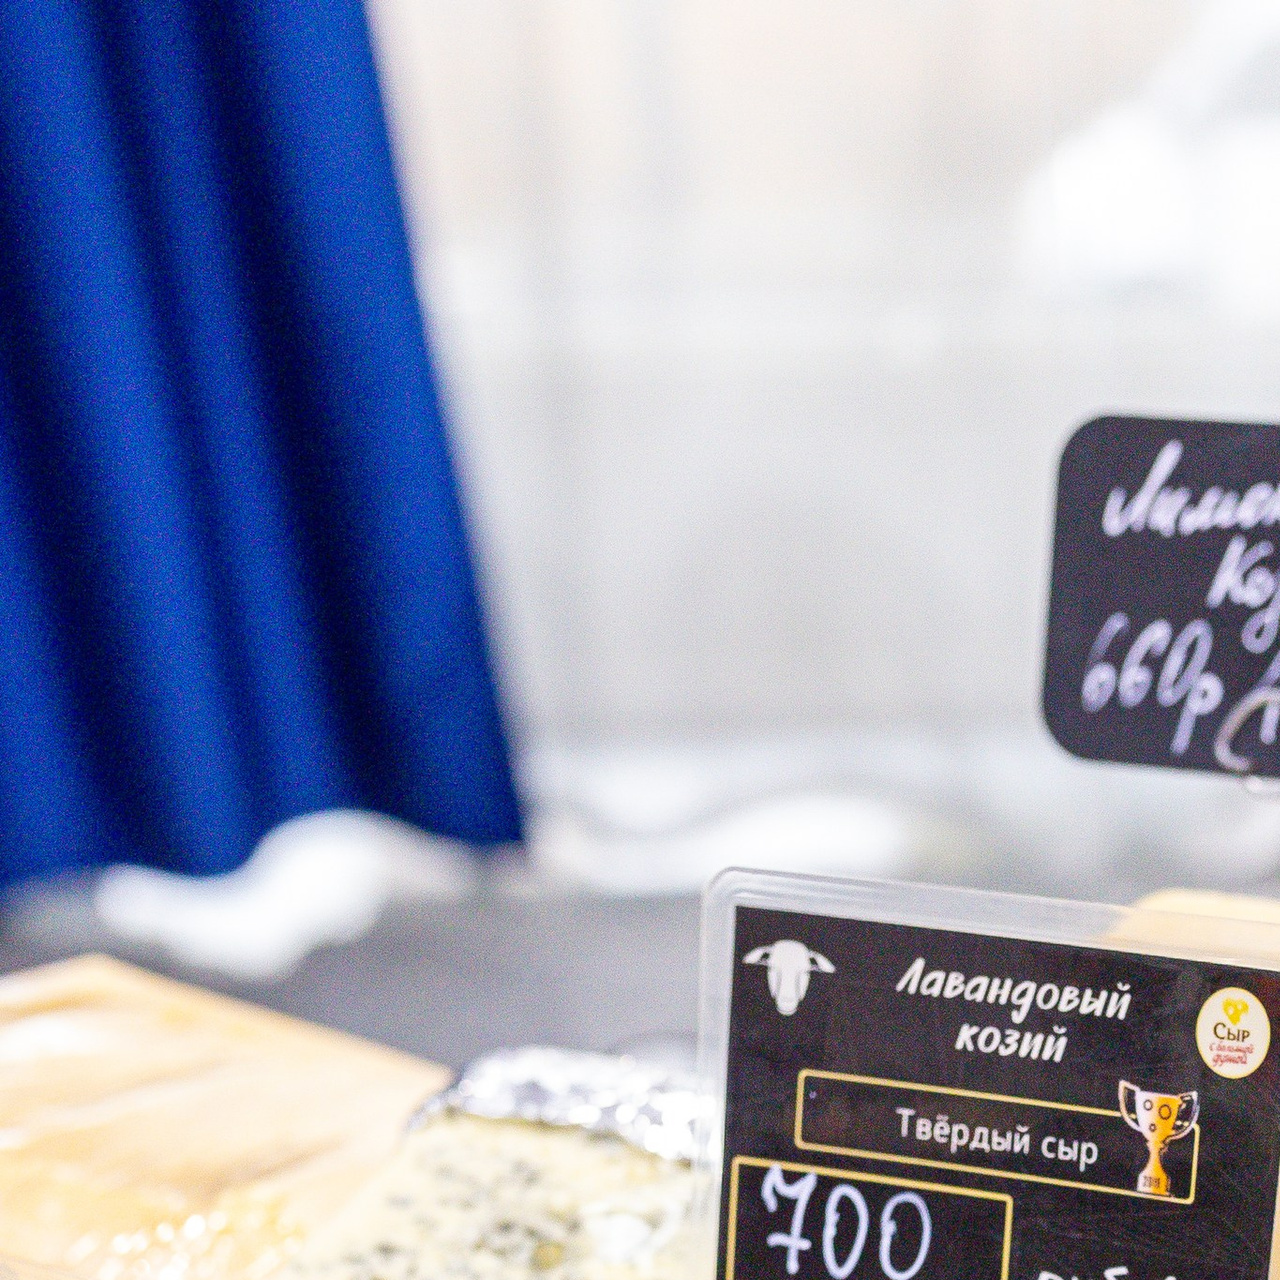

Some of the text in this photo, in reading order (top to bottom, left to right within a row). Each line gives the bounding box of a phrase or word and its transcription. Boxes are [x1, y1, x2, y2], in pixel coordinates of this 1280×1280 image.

[896, 956, 1132, 1024] Лавандовый
[955, 1022, 1069, 1063] козий
[896, 1107, 1099, 1172] Твёрдый сыр
